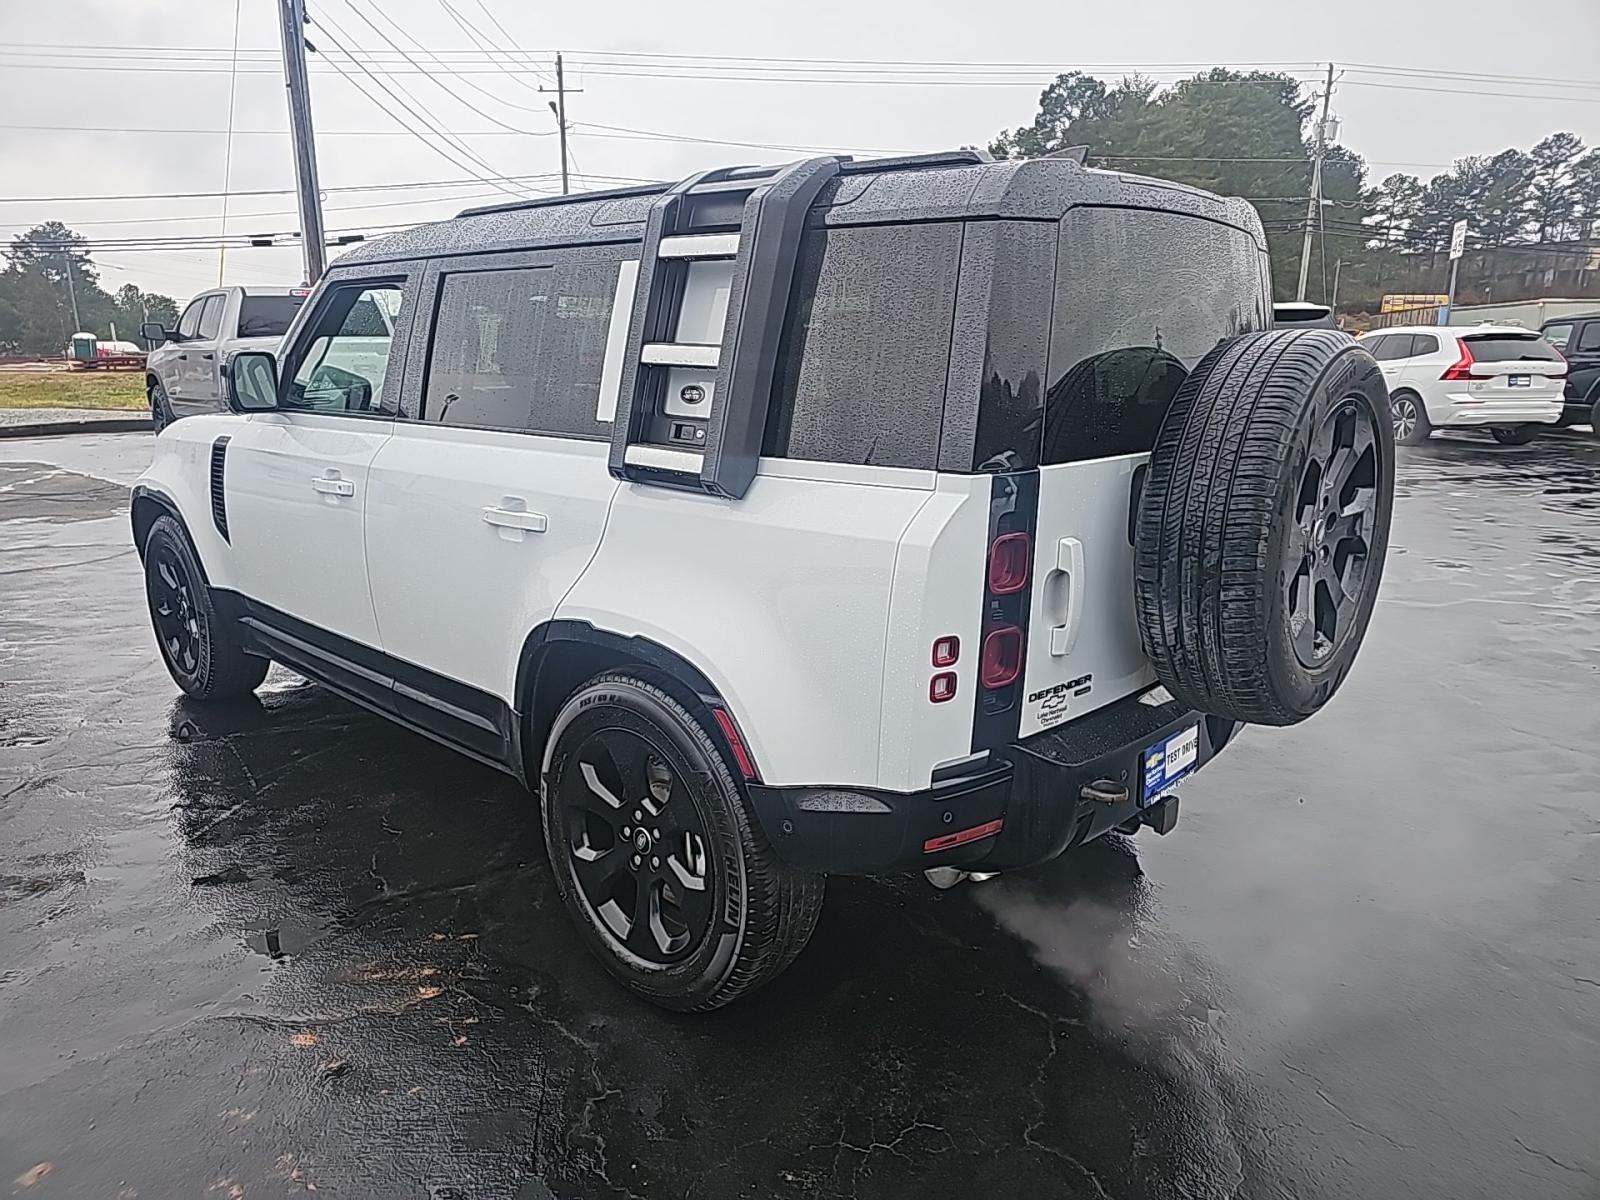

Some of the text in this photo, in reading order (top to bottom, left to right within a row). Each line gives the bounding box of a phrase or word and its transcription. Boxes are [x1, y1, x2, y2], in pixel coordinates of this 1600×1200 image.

[1452, 240, 1463, 254] 45
[1029, 674, 1092, 703] DEFENDER
[1167, 737, 1198, 765] TEST DRIVE
